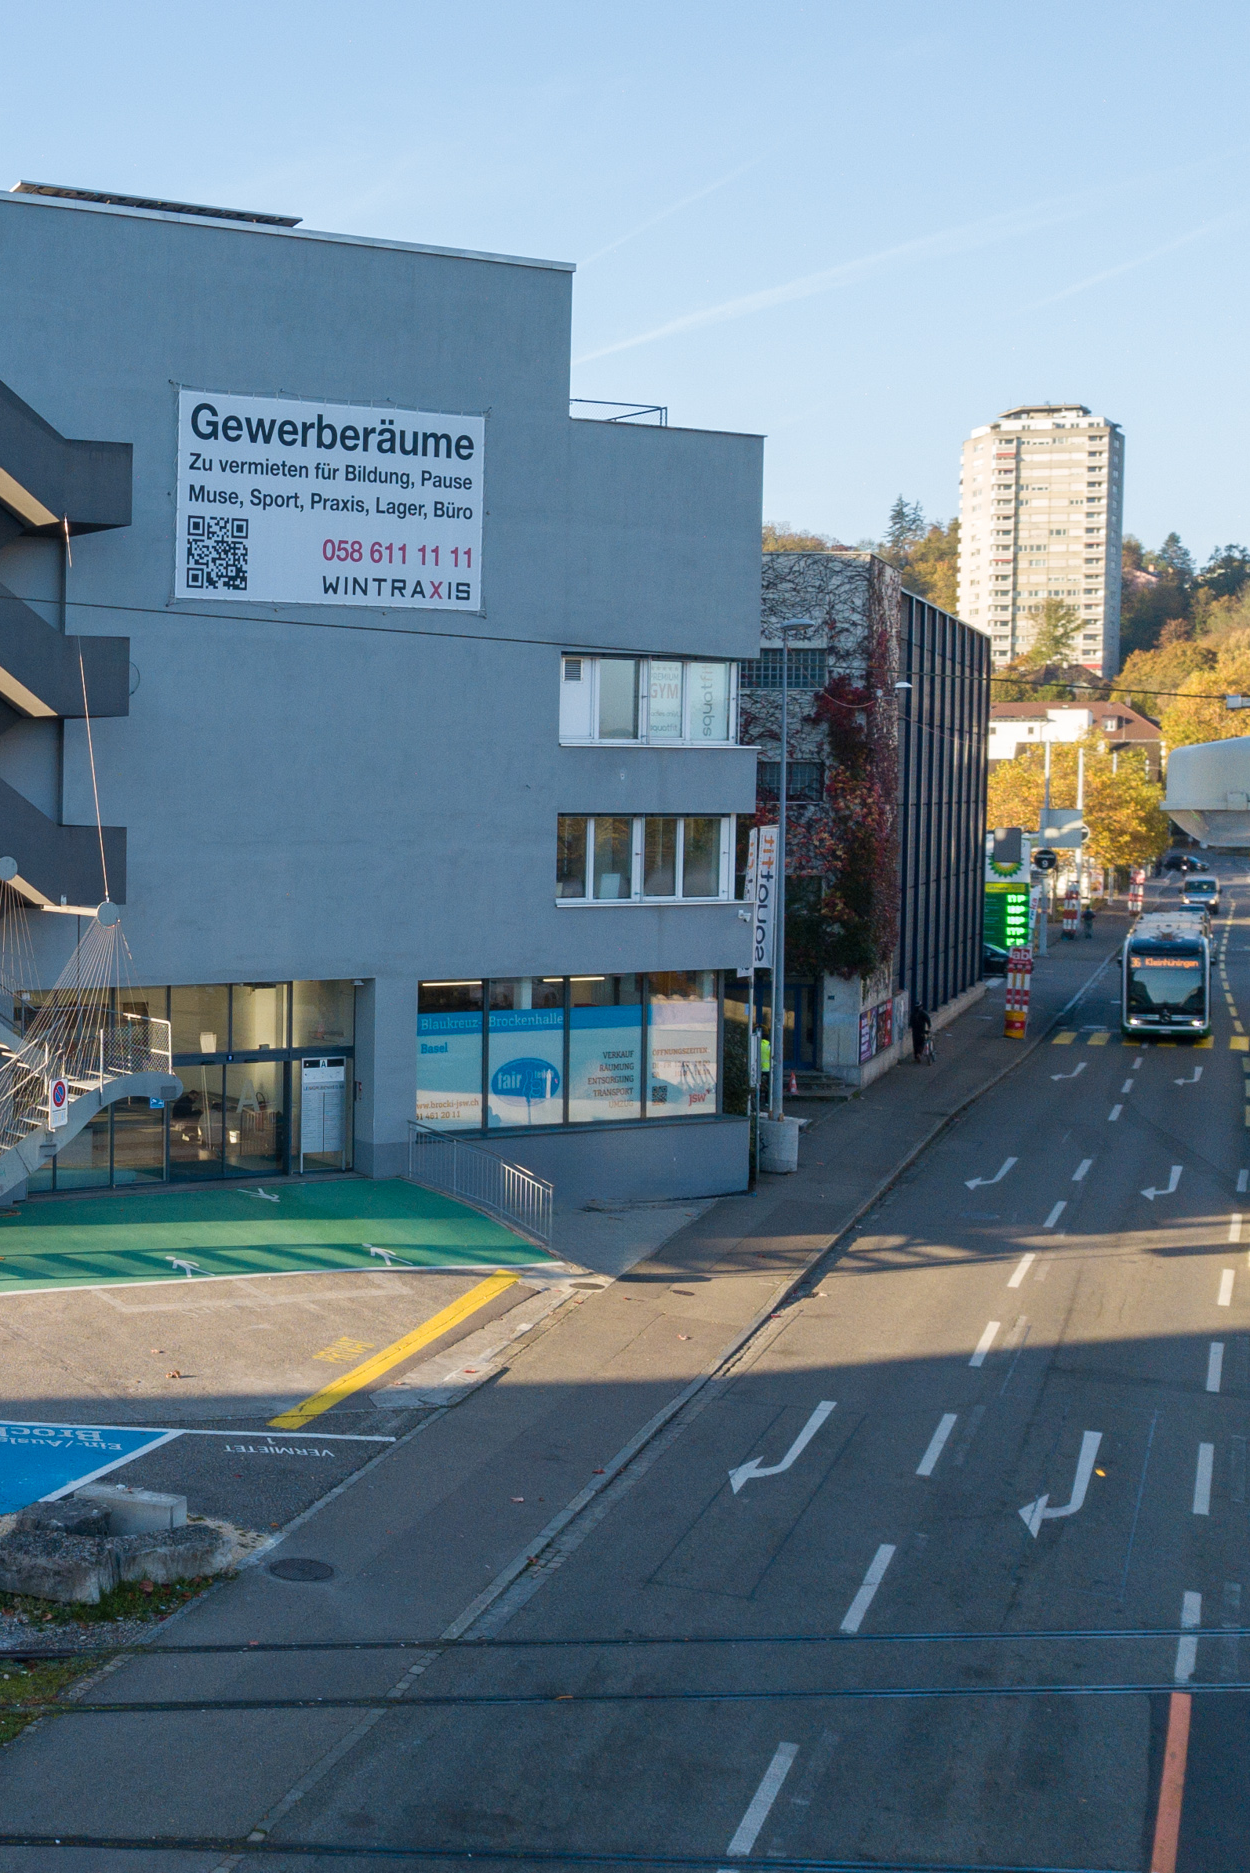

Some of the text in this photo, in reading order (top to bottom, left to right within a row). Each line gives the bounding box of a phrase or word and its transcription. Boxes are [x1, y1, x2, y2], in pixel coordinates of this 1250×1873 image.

[190, 403, 475, 461] Gewerberäume
[189, 453, 473, 490] Zu vermieten für Bildung, Pause
[188, 484, 474, 521] Muse, Sport, Praxis, Lager, Büro
[322, 538, 473, 569] 058 611 11 11
[321, 575, 471, 601] WINTRAXIS
[650, 683, 679, 699] GYM
[700, 664, 716, 737] squatfit
[1131, 957, 1199, 969] 36 Kleinhüningen
[420, 1012, 564, 1032] Blaukreuz- Brockenhalle
[420, 1042, 449, 1055] Basel
[602, 1050, 635, 1060] VERKAUF
[497, 1071, 523, 1090] fair
[587, 1075, 635, 1086] ENTSORGUNG
[236, 1078, 261, 1114] A
[592, 1087, 634, 1098] TRANSPORT
[608, 1100, 634, 1109] UMZUG
[425, 1112, 439, 1120] 461
[441, 1111, 451, 1119] 20
[452, 1110, 461, 1118] 11
[223, 1444, 336, 1458] VERMIETET
